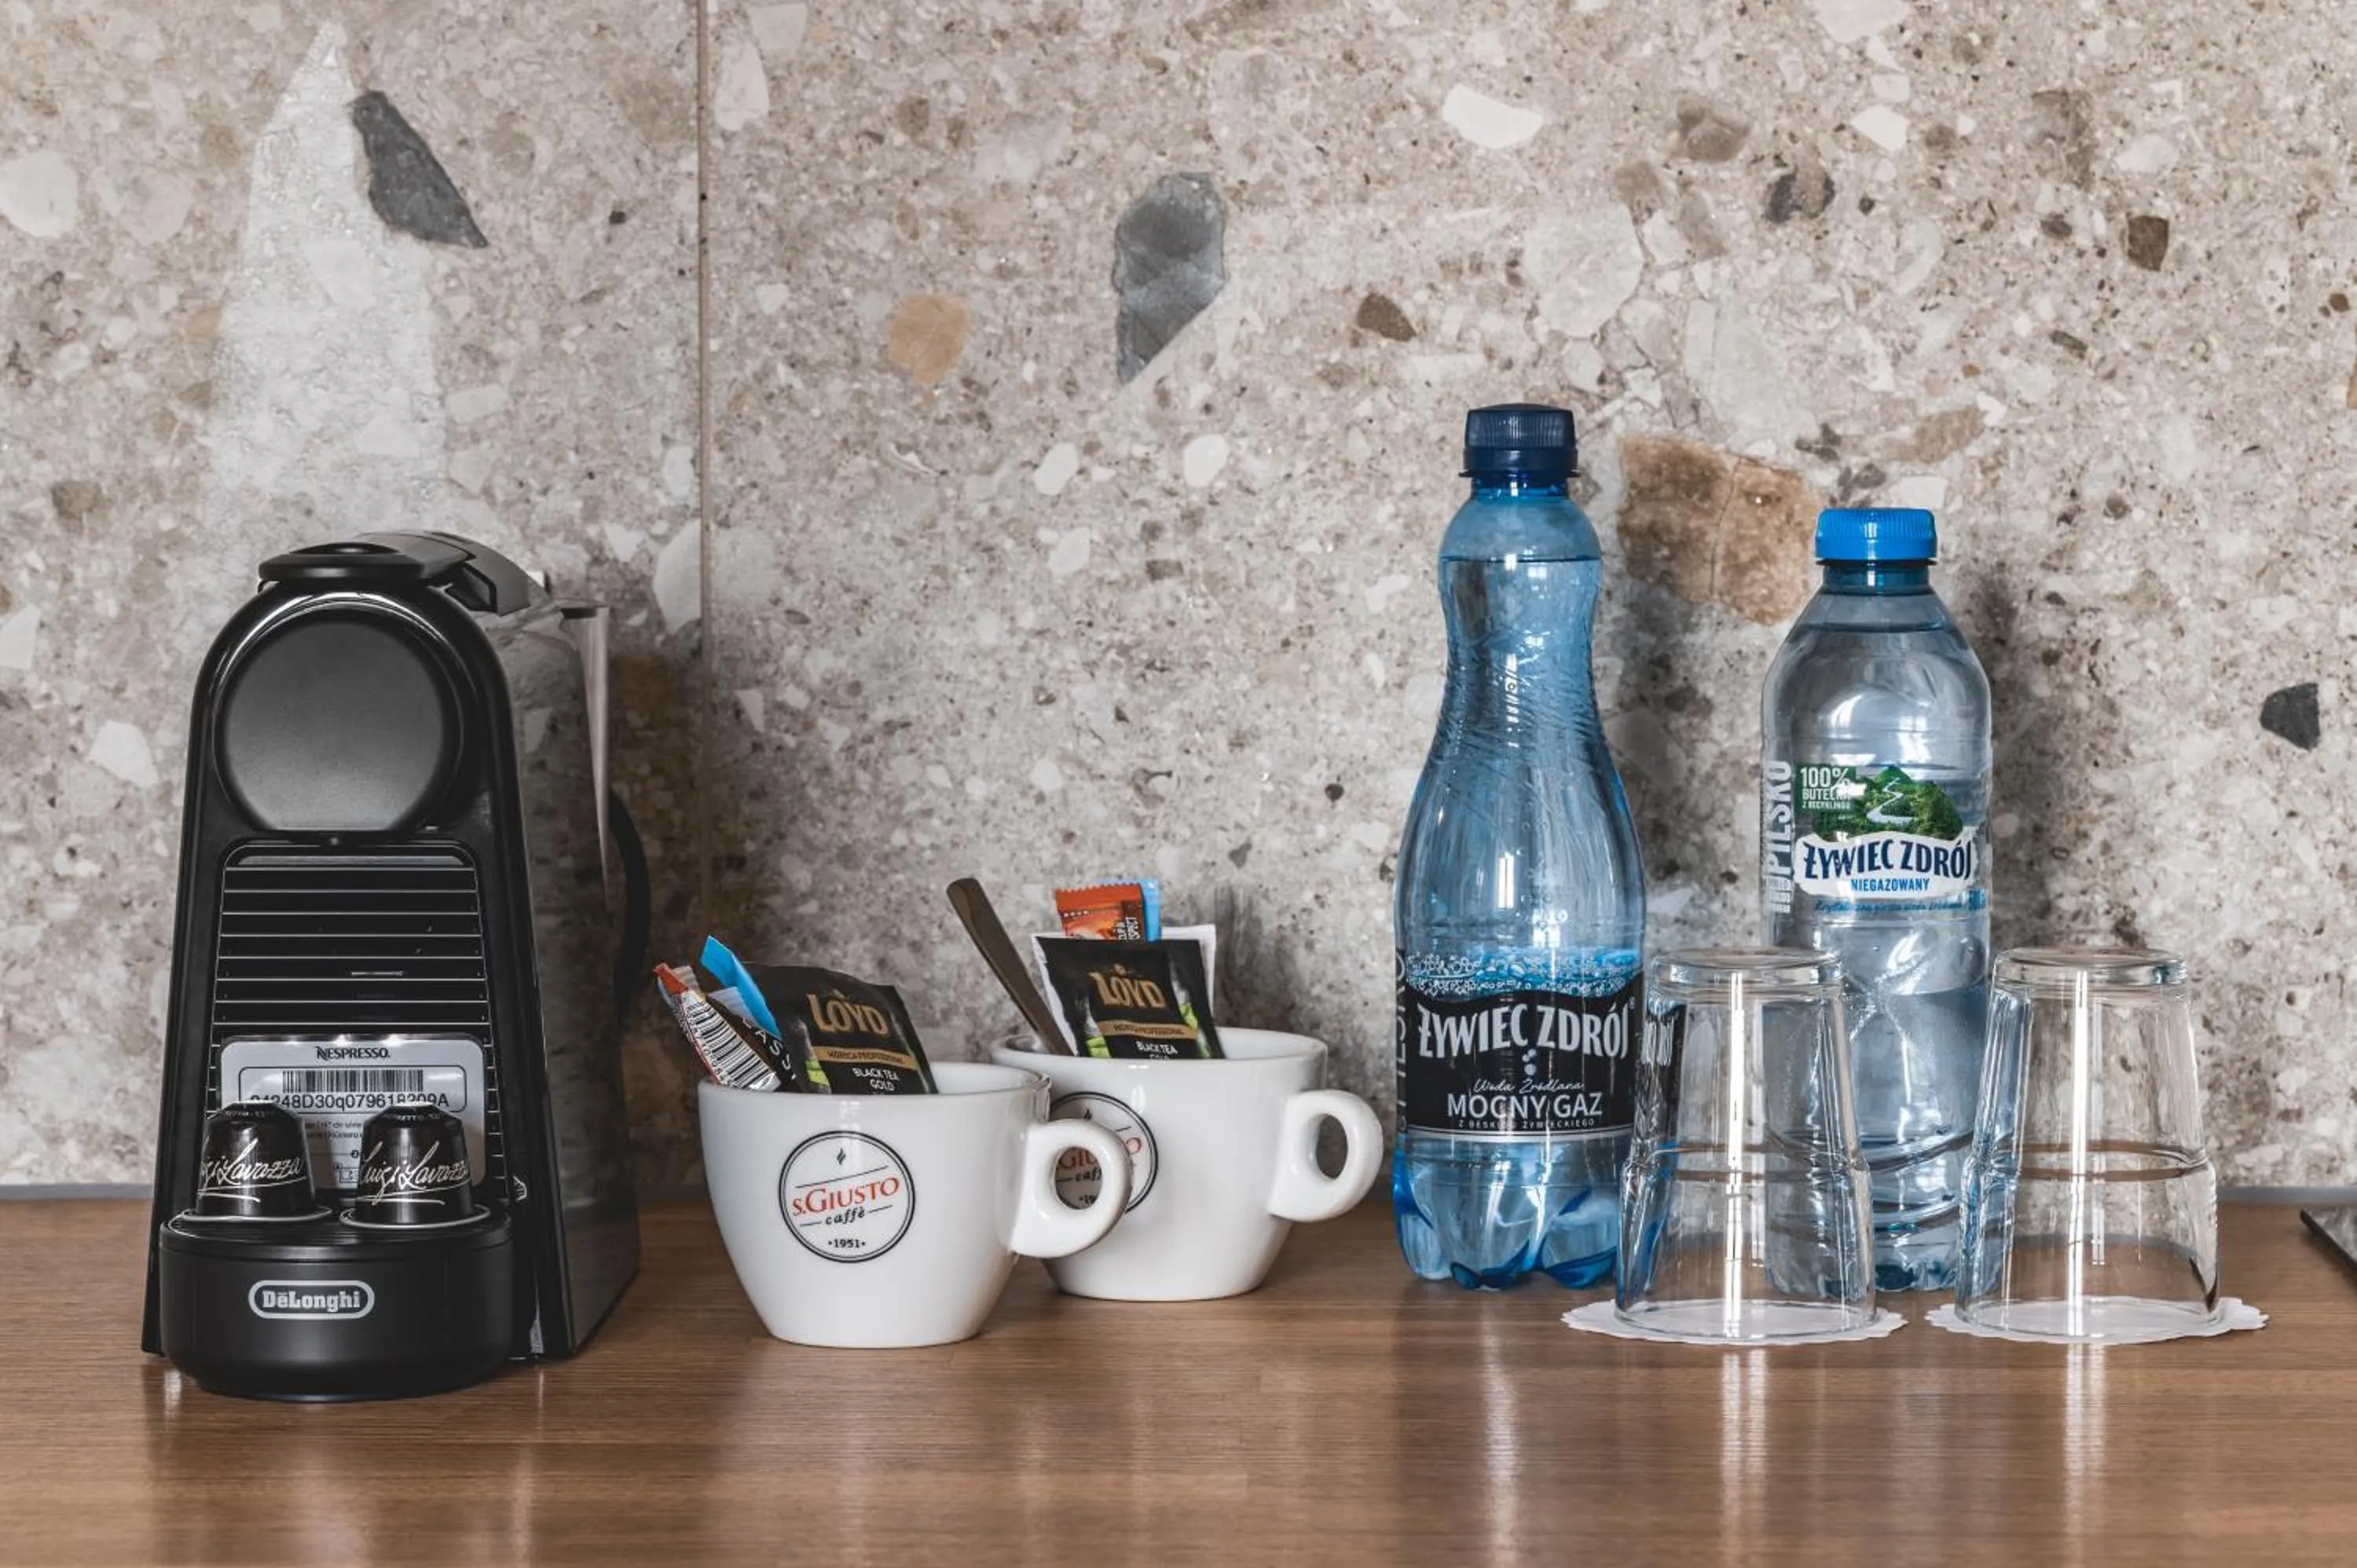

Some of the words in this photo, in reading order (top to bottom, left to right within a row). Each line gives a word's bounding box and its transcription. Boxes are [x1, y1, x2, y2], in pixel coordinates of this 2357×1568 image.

[1800, 767, 1850, 789] 100%
[1802, 839, 1894, 880] ŻYWIEC
[1900, 840, 1972, 881] ZDRÓJ
[1850, 877, 1930, 892] NIEGAZOWANY
[1417, 1002, 1529, 1059] ŻYWIEC
[1537, 1001, 1629, 1060] ZDRÓJ
[315, 1046, 390, 1061] NESPRESSO
[1160, 1043, 1178, 1054] TEA
[852, 1068, 883, 1079] BLACK
[882, 1068, 900, 1082] TEA
[870, 1078, 895, 1092] GOLD
[1447, 1093, 1547, 1119] MOCNY
[1553, 1092, 1604, 1119] GAZ
[825, 1207, 866, 1225] caffè
